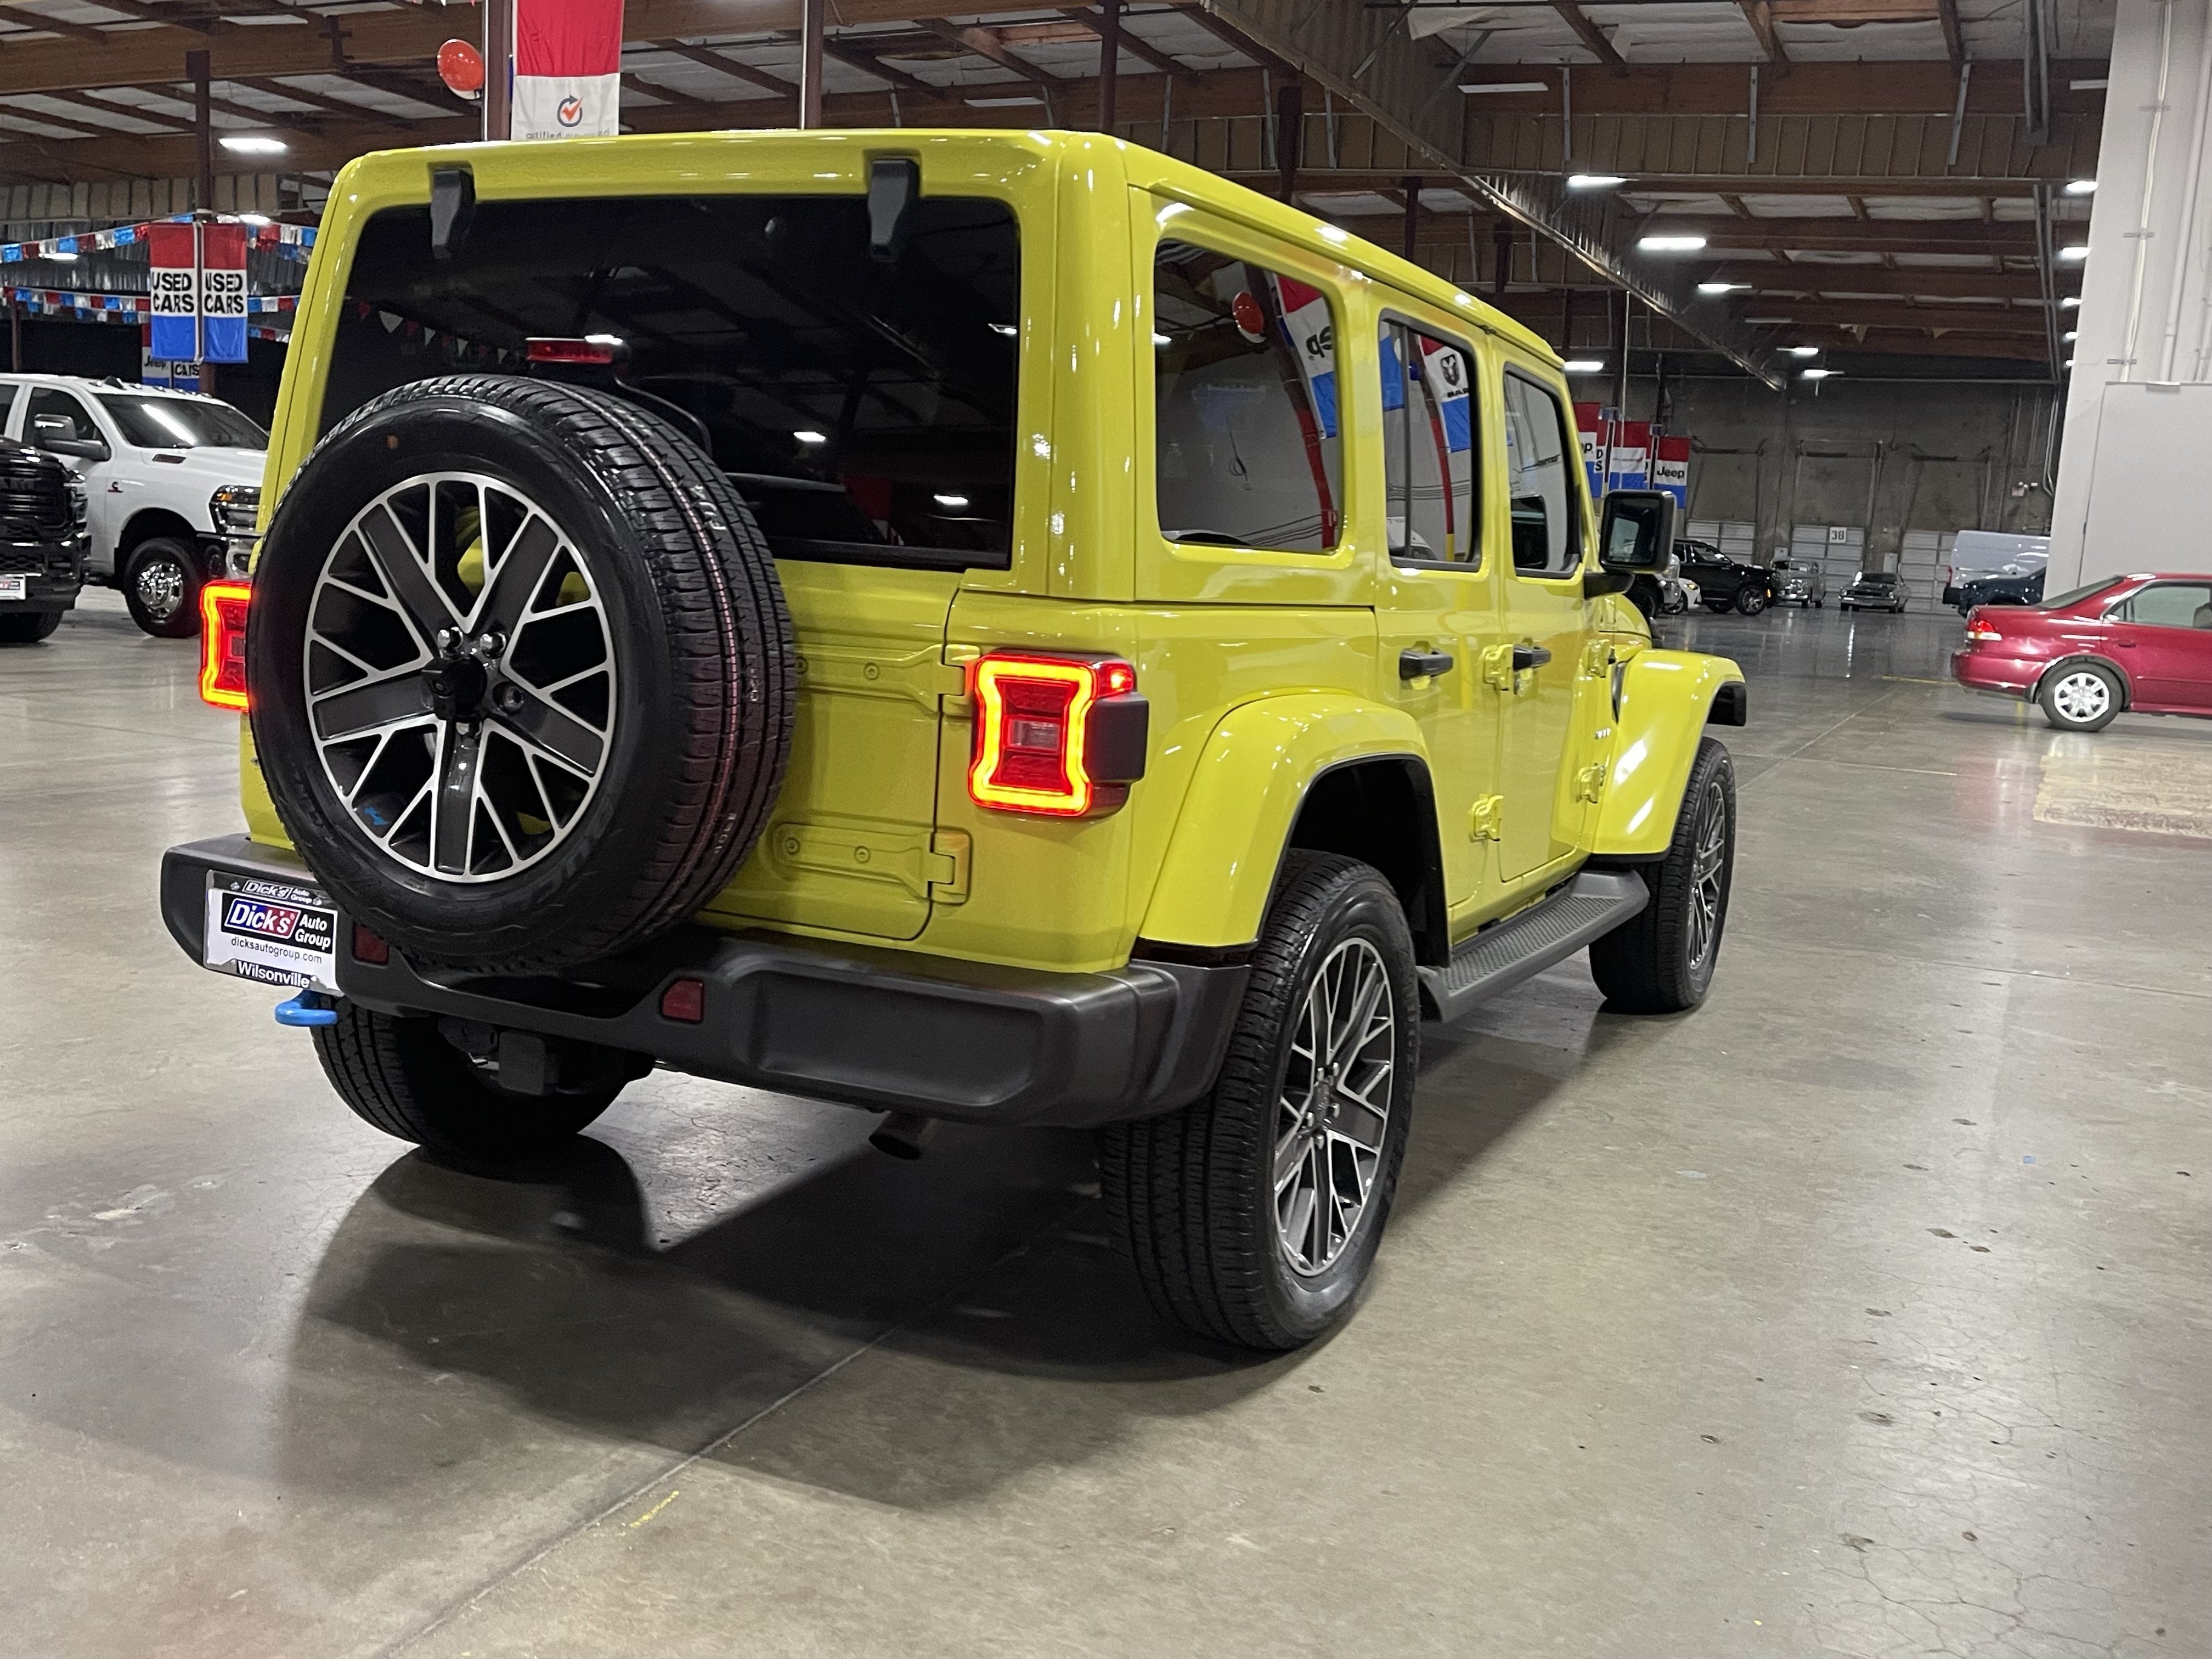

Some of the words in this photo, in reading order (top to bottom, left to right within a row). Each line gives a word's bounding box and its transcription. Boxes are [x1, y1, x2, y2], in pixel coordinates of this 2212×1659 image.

[153, 273, 192, 291] USED
[205, 273, 243, 292] USED
[153, 294, 194, 312] CARS
[204, 294, 244, 313] CARS
[1657, 466, 1684, 479] Jeep
[1831, 530, 1844, 540] 38
[245, 882, 290, 898] Dick's
[290, 894, 312, 904] Group
[230, 904, 291, 934] Dick's
[299, 914, 328, 931] Auto
[295, 928, 331, 950] Group
[231, 936, 322, 964] dicksautogroup.com
[238, 961, 311, 988] Wilsonville
